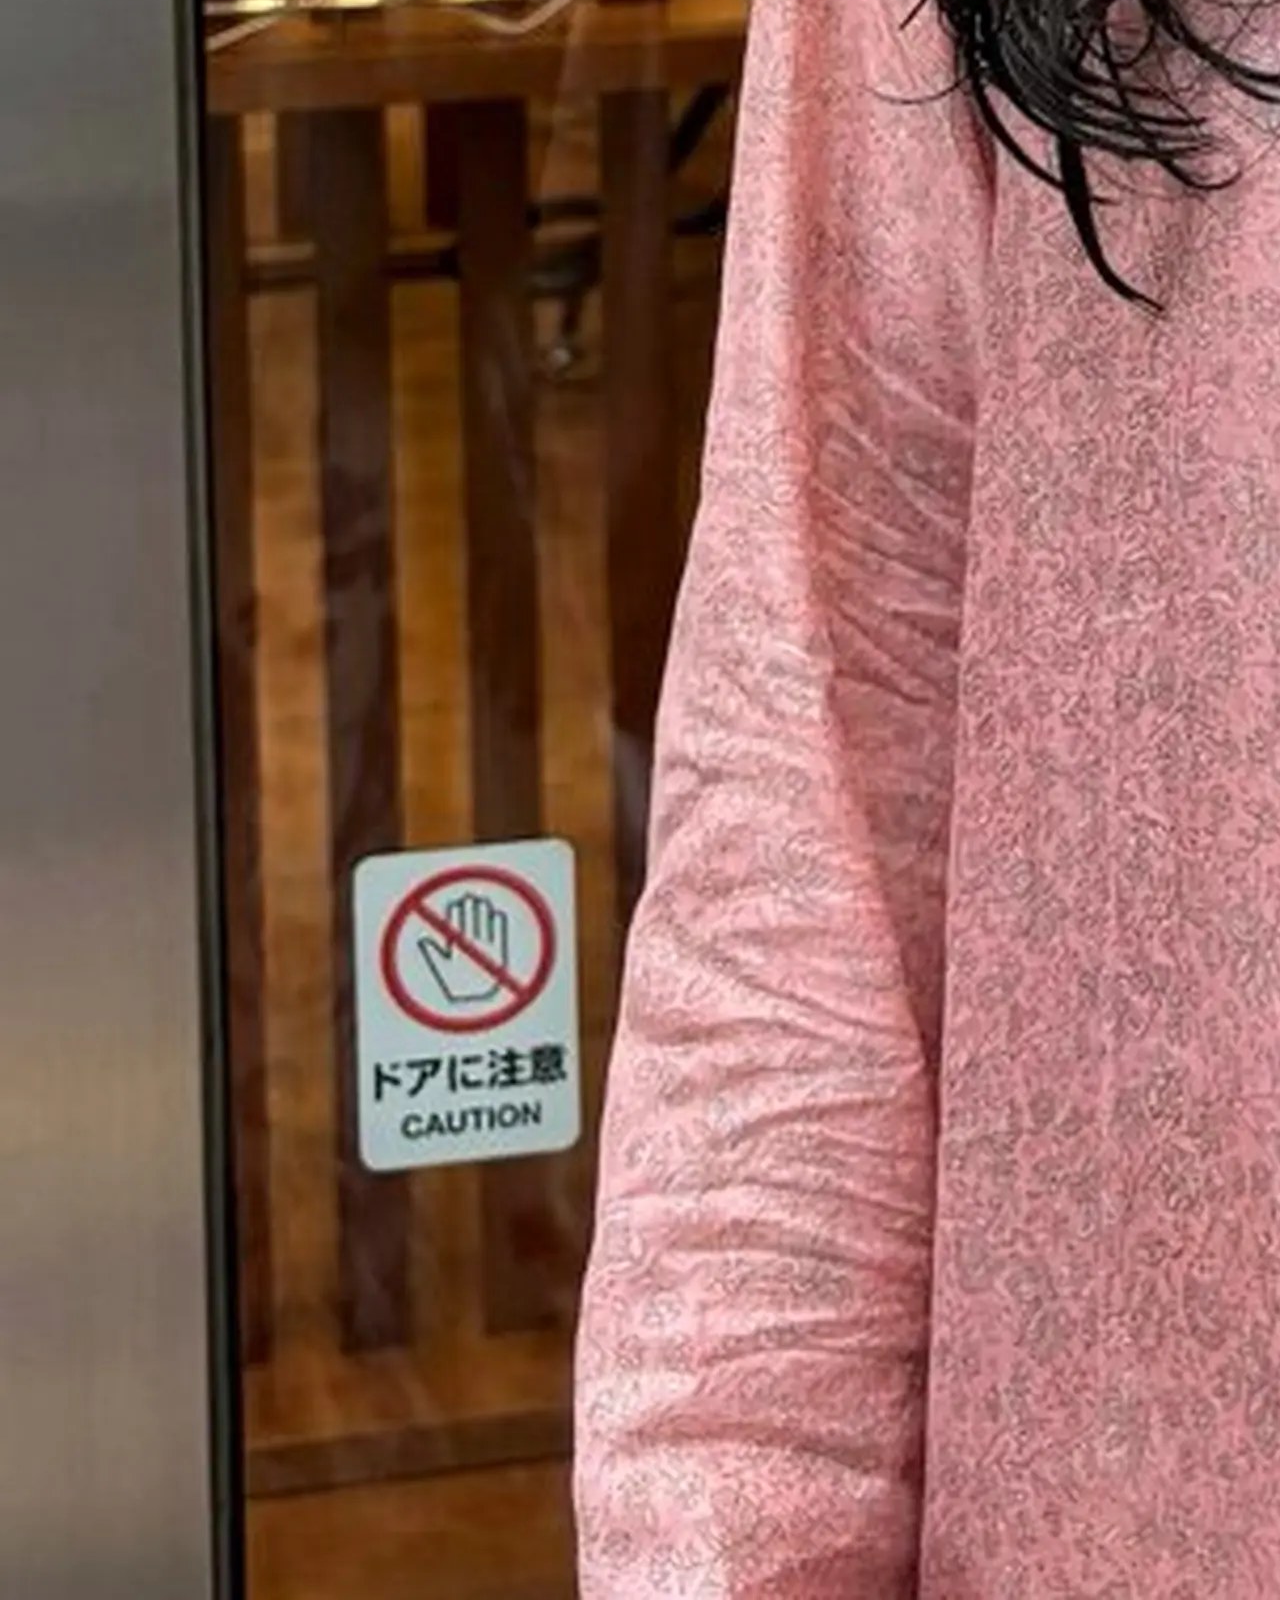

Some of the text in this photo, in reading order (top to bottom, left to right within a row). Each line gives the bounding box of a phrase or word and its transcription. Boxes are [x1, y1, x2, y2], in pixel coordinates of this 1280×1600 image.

[373, 1042, 568, 1101] ドアに注意
[400, 1100, 543, 1140] CAUTION
